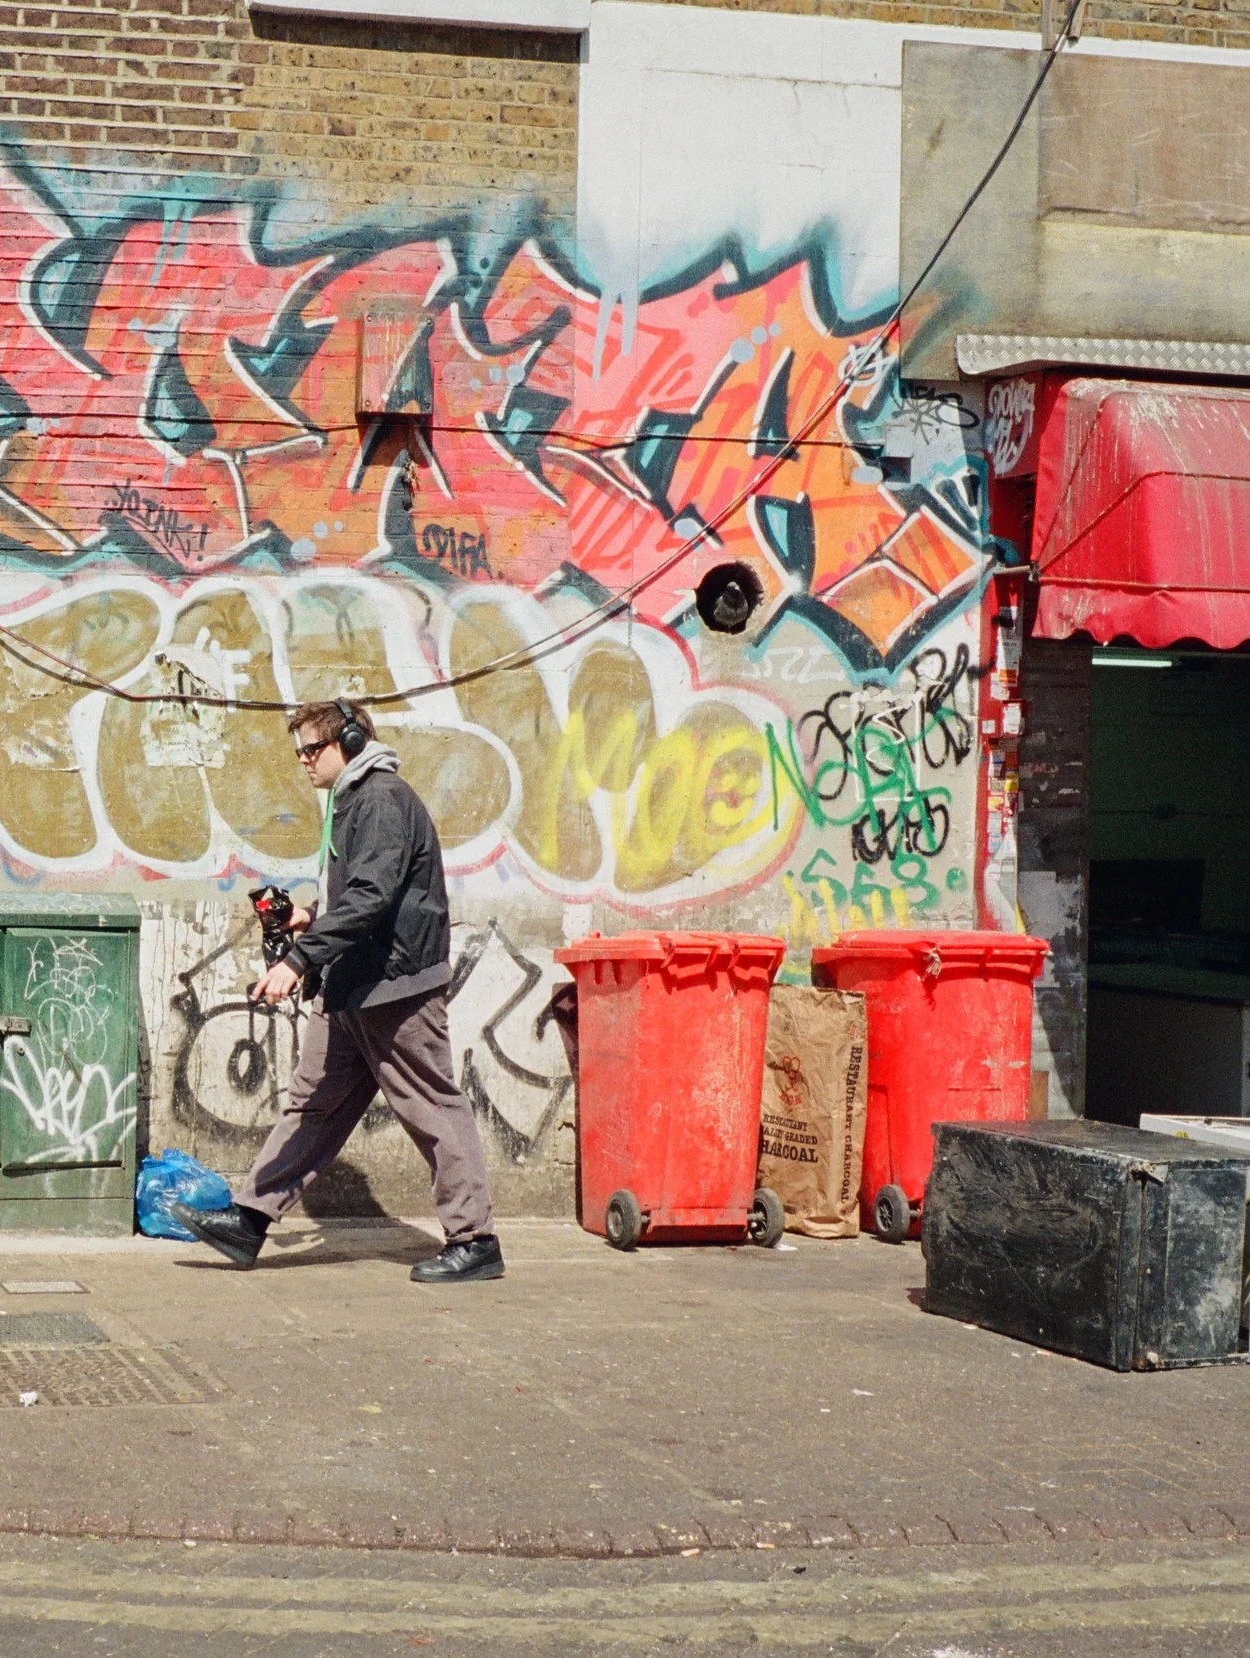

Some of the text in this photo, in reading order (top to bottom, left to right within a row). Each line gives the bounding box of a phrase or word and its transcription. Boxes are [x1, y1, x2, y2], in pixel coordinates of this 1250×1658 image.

[784, 1131, 819, 1146] GRADED
[760, 1139, 819, 1164] HARCOAL
[840, 1134, 853, 1204] CHARCOAL
